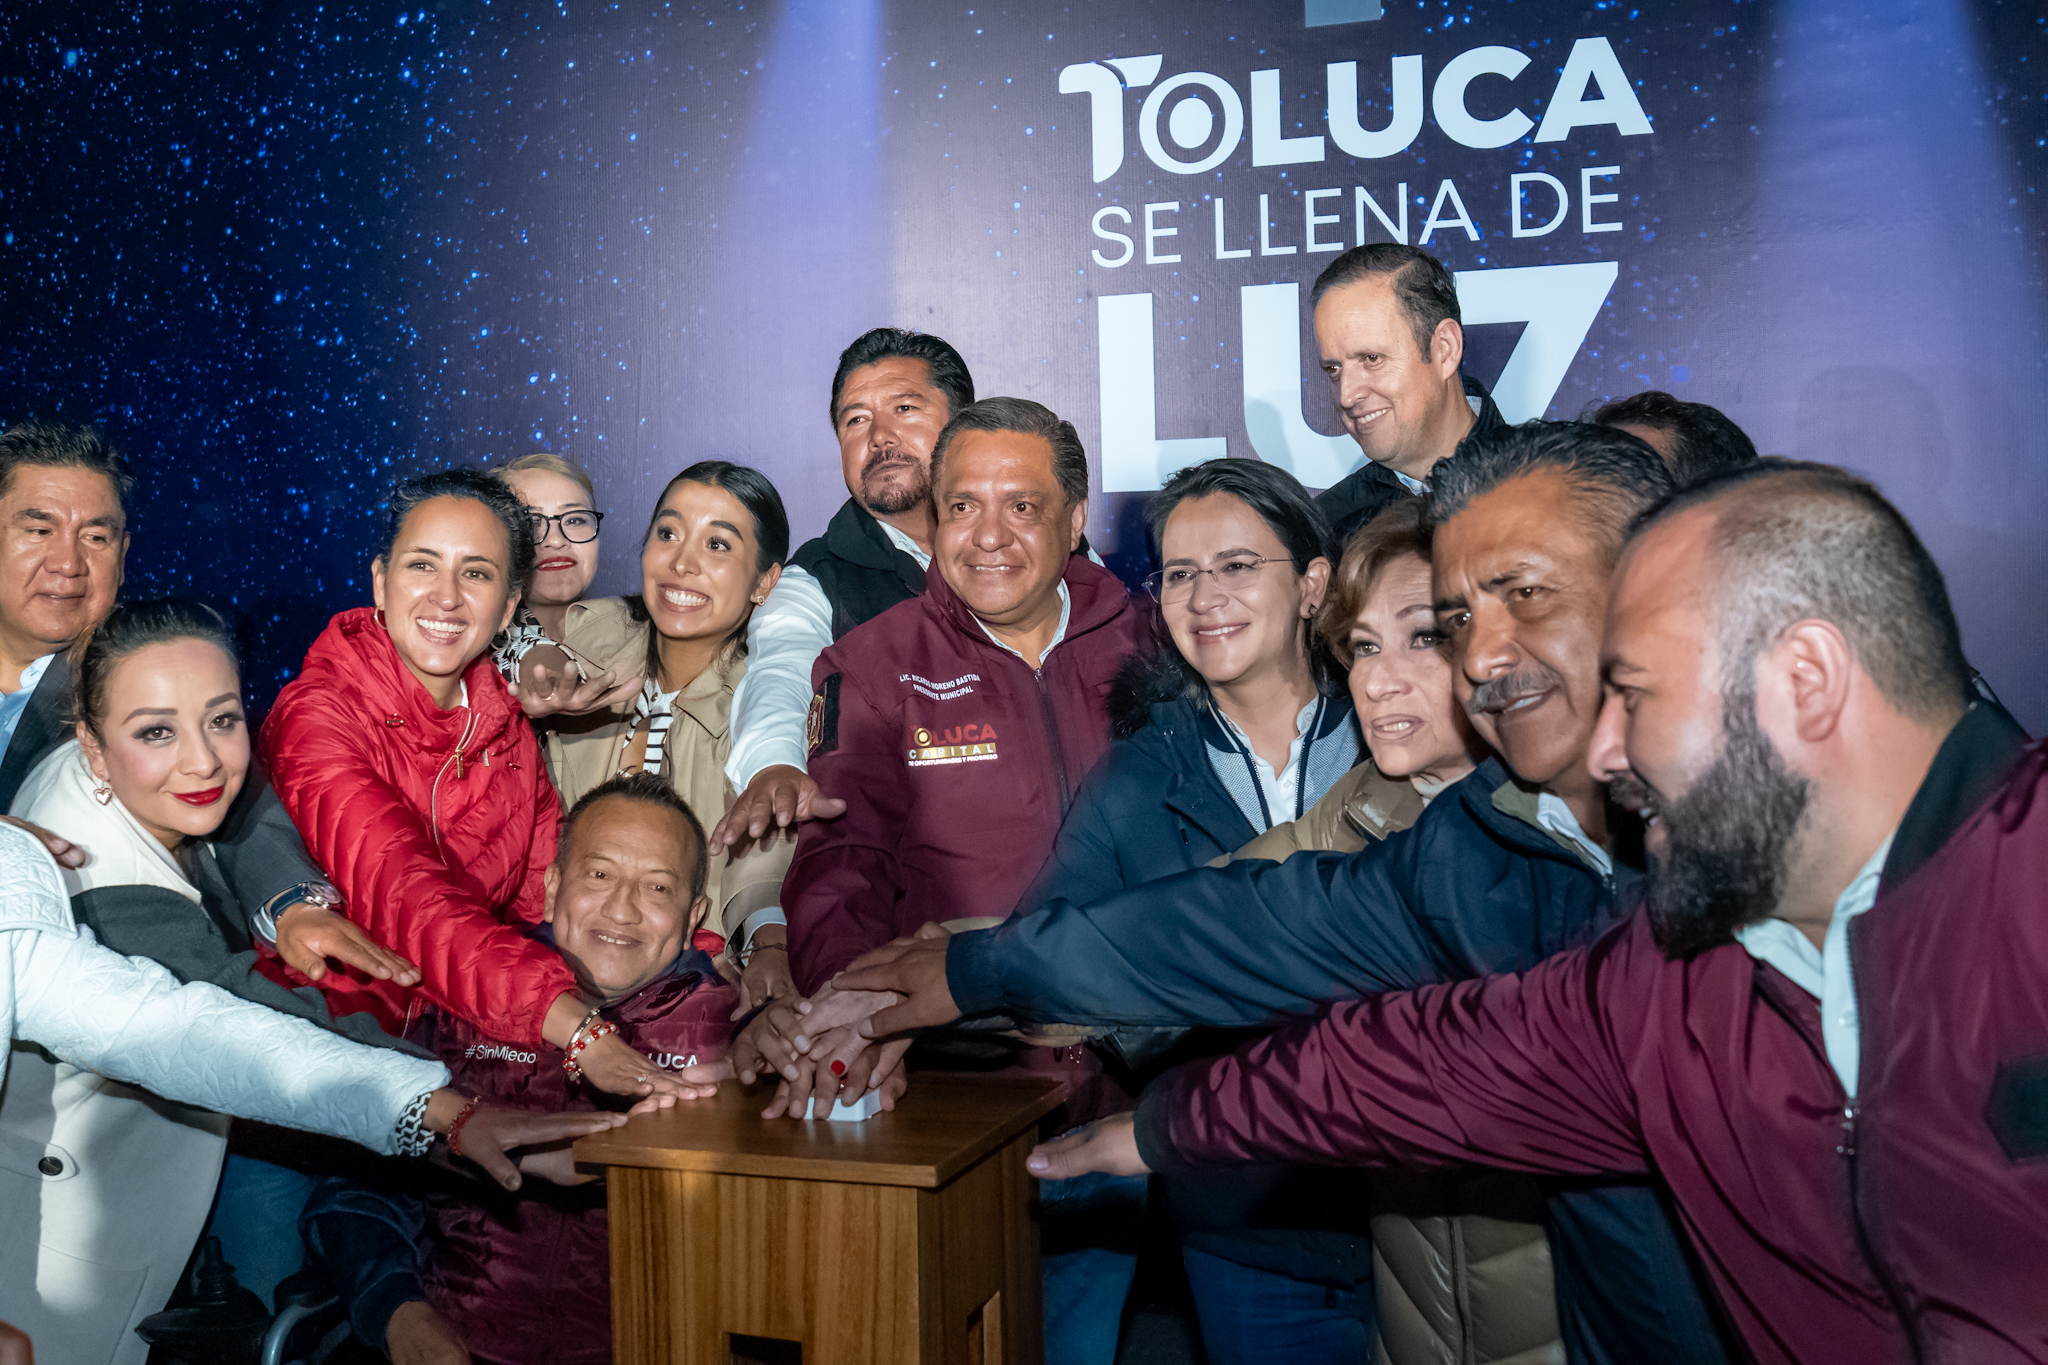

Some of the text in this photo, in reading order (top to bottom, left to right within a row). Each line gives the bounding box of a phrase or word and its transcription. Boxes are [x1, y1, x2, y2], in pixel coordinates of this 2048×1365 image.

[1059, 37, 1654, 183] TOLUCA
[1091, 165, 1623, 268] SE LLENA DE
[899, 673, 912, 683] LIC.
[931, 680, 956, 690] MORENO
[955, 673, 981, 686] BASTIDA
[940, 685, 974, 700] MUNICIPAL
[909, 743, 994, 759] CAPITAL
[914, 757, 962, 766] OPORTUNIDADES
[967, 753, 998, 762] PROGRESO
